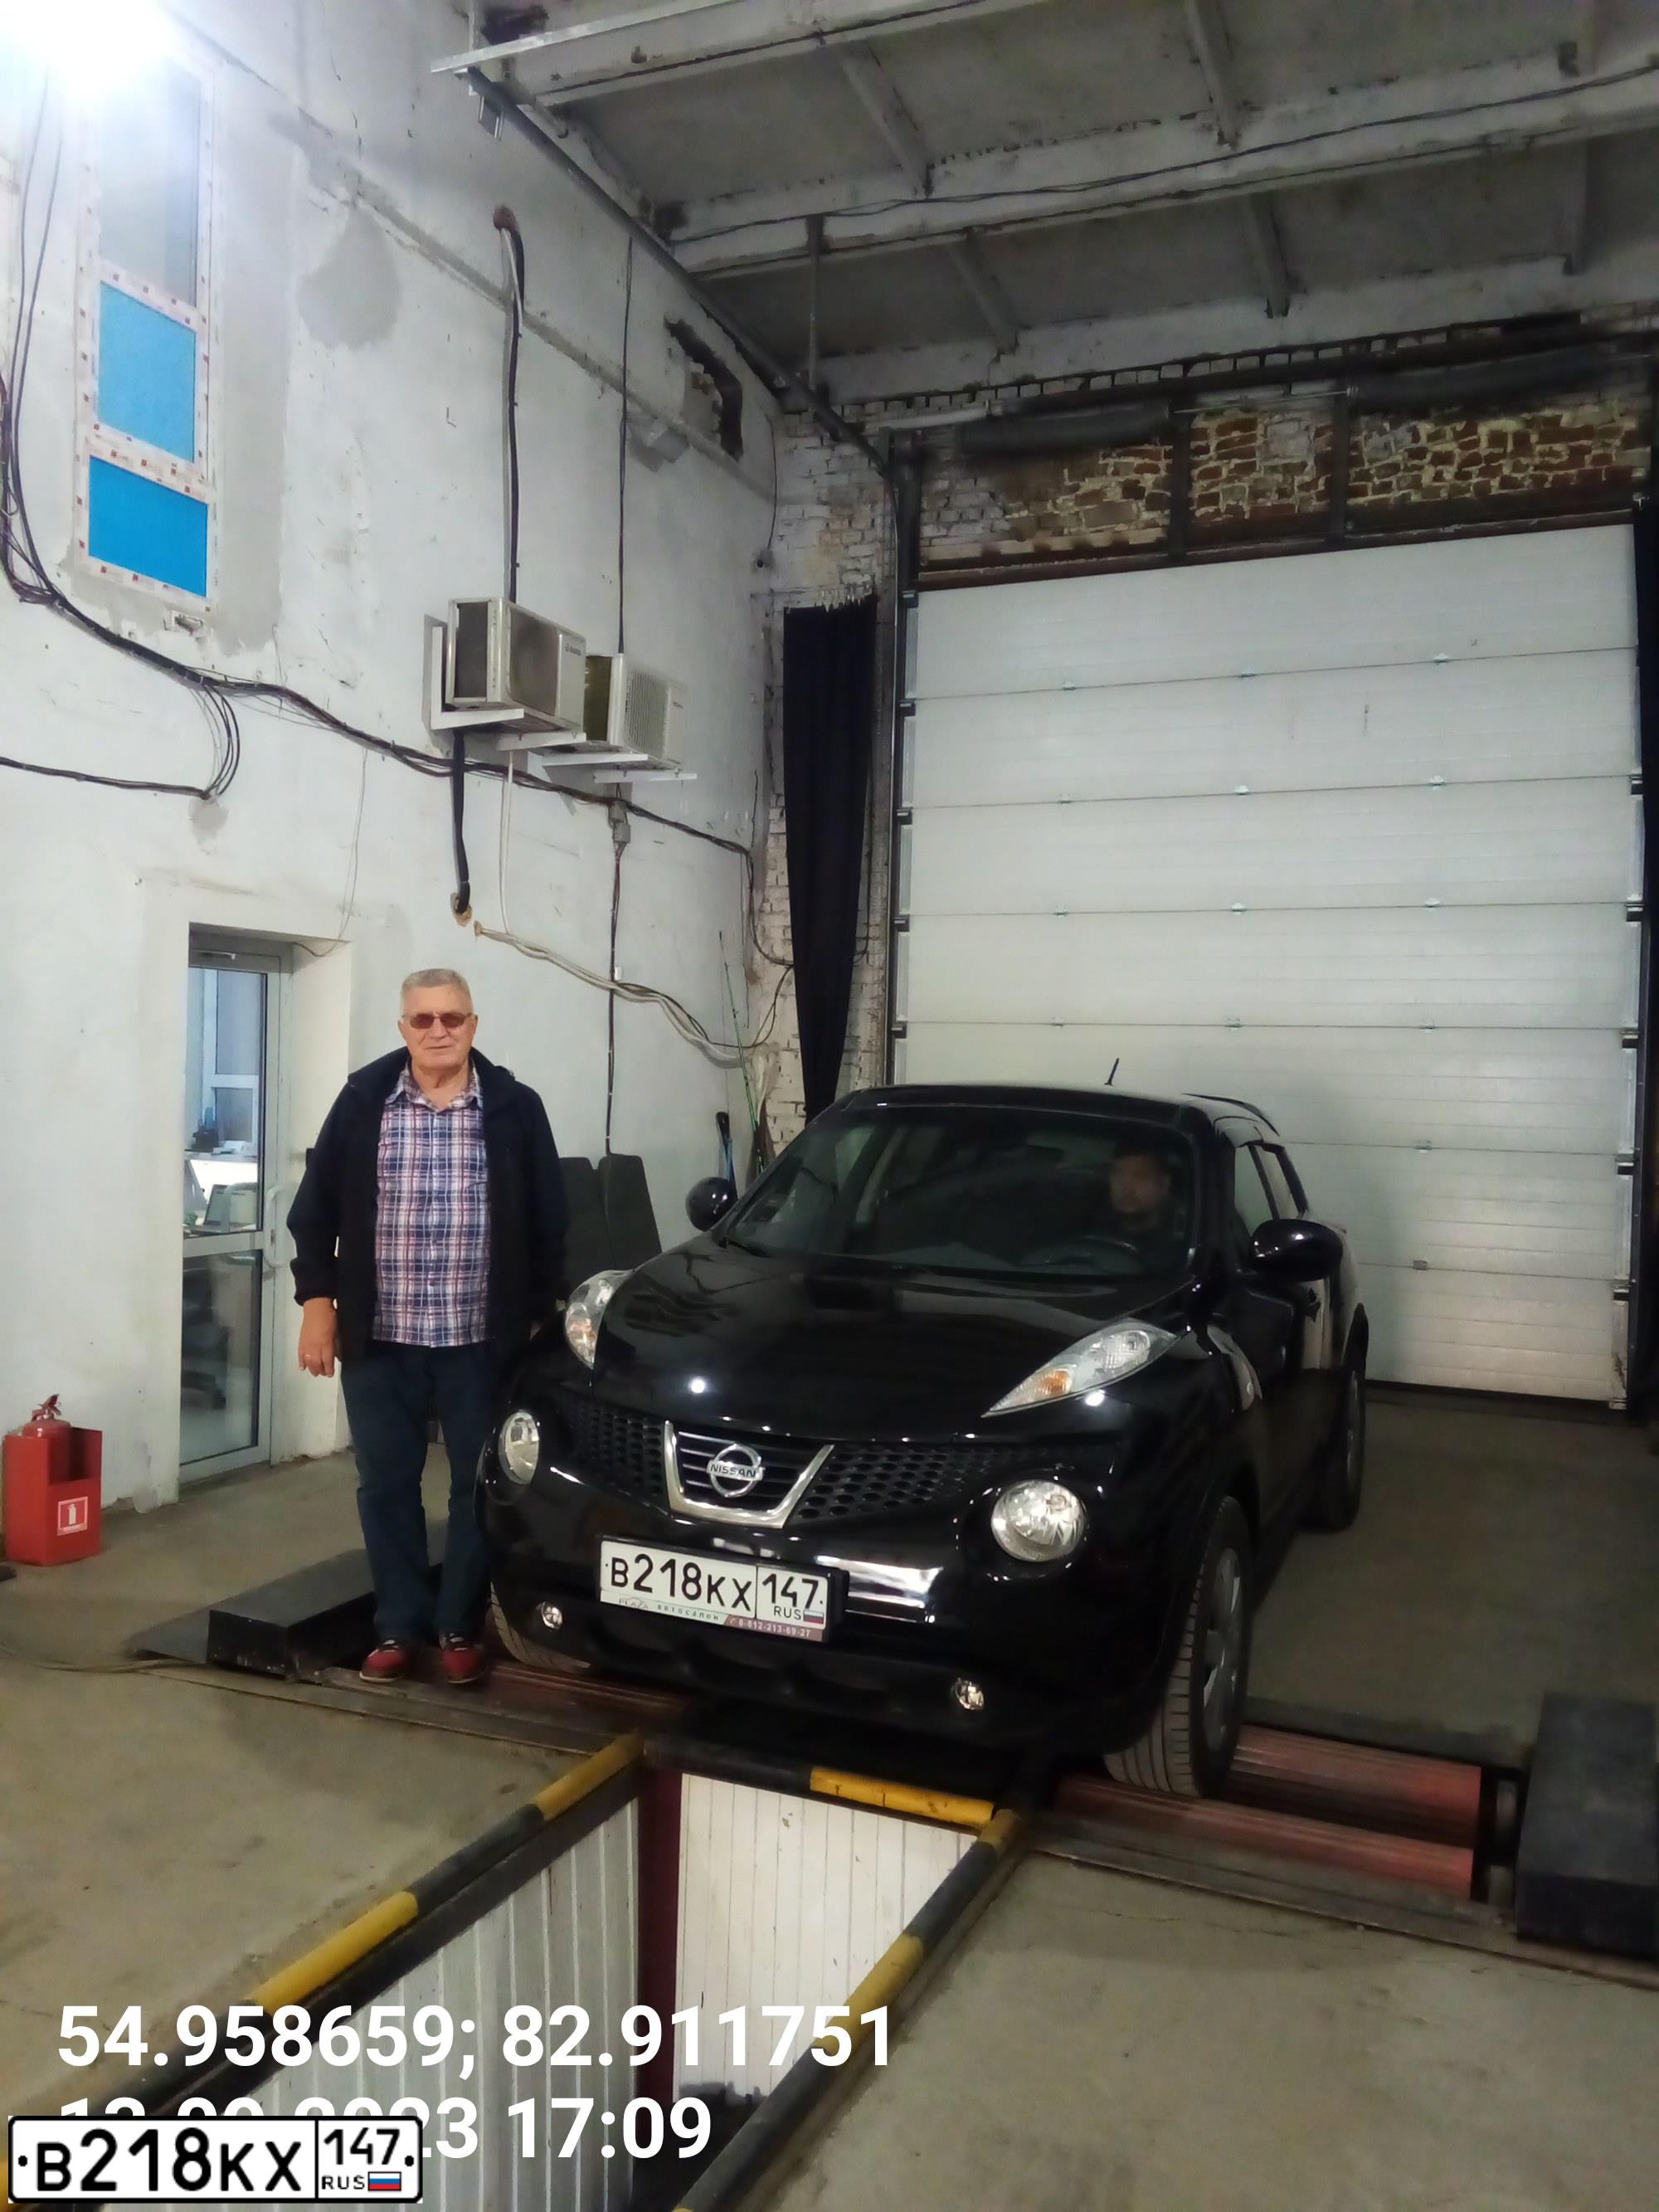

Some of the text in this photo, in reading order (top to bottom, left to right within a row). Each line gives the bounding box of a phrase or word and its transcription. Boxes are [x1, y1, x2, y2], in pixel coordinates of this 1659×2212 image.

[710, 1464, 757, 1478] NISSAN
[762, 1573, 819, 1609] 147
[773, 1605, 802, 1620] RUS
